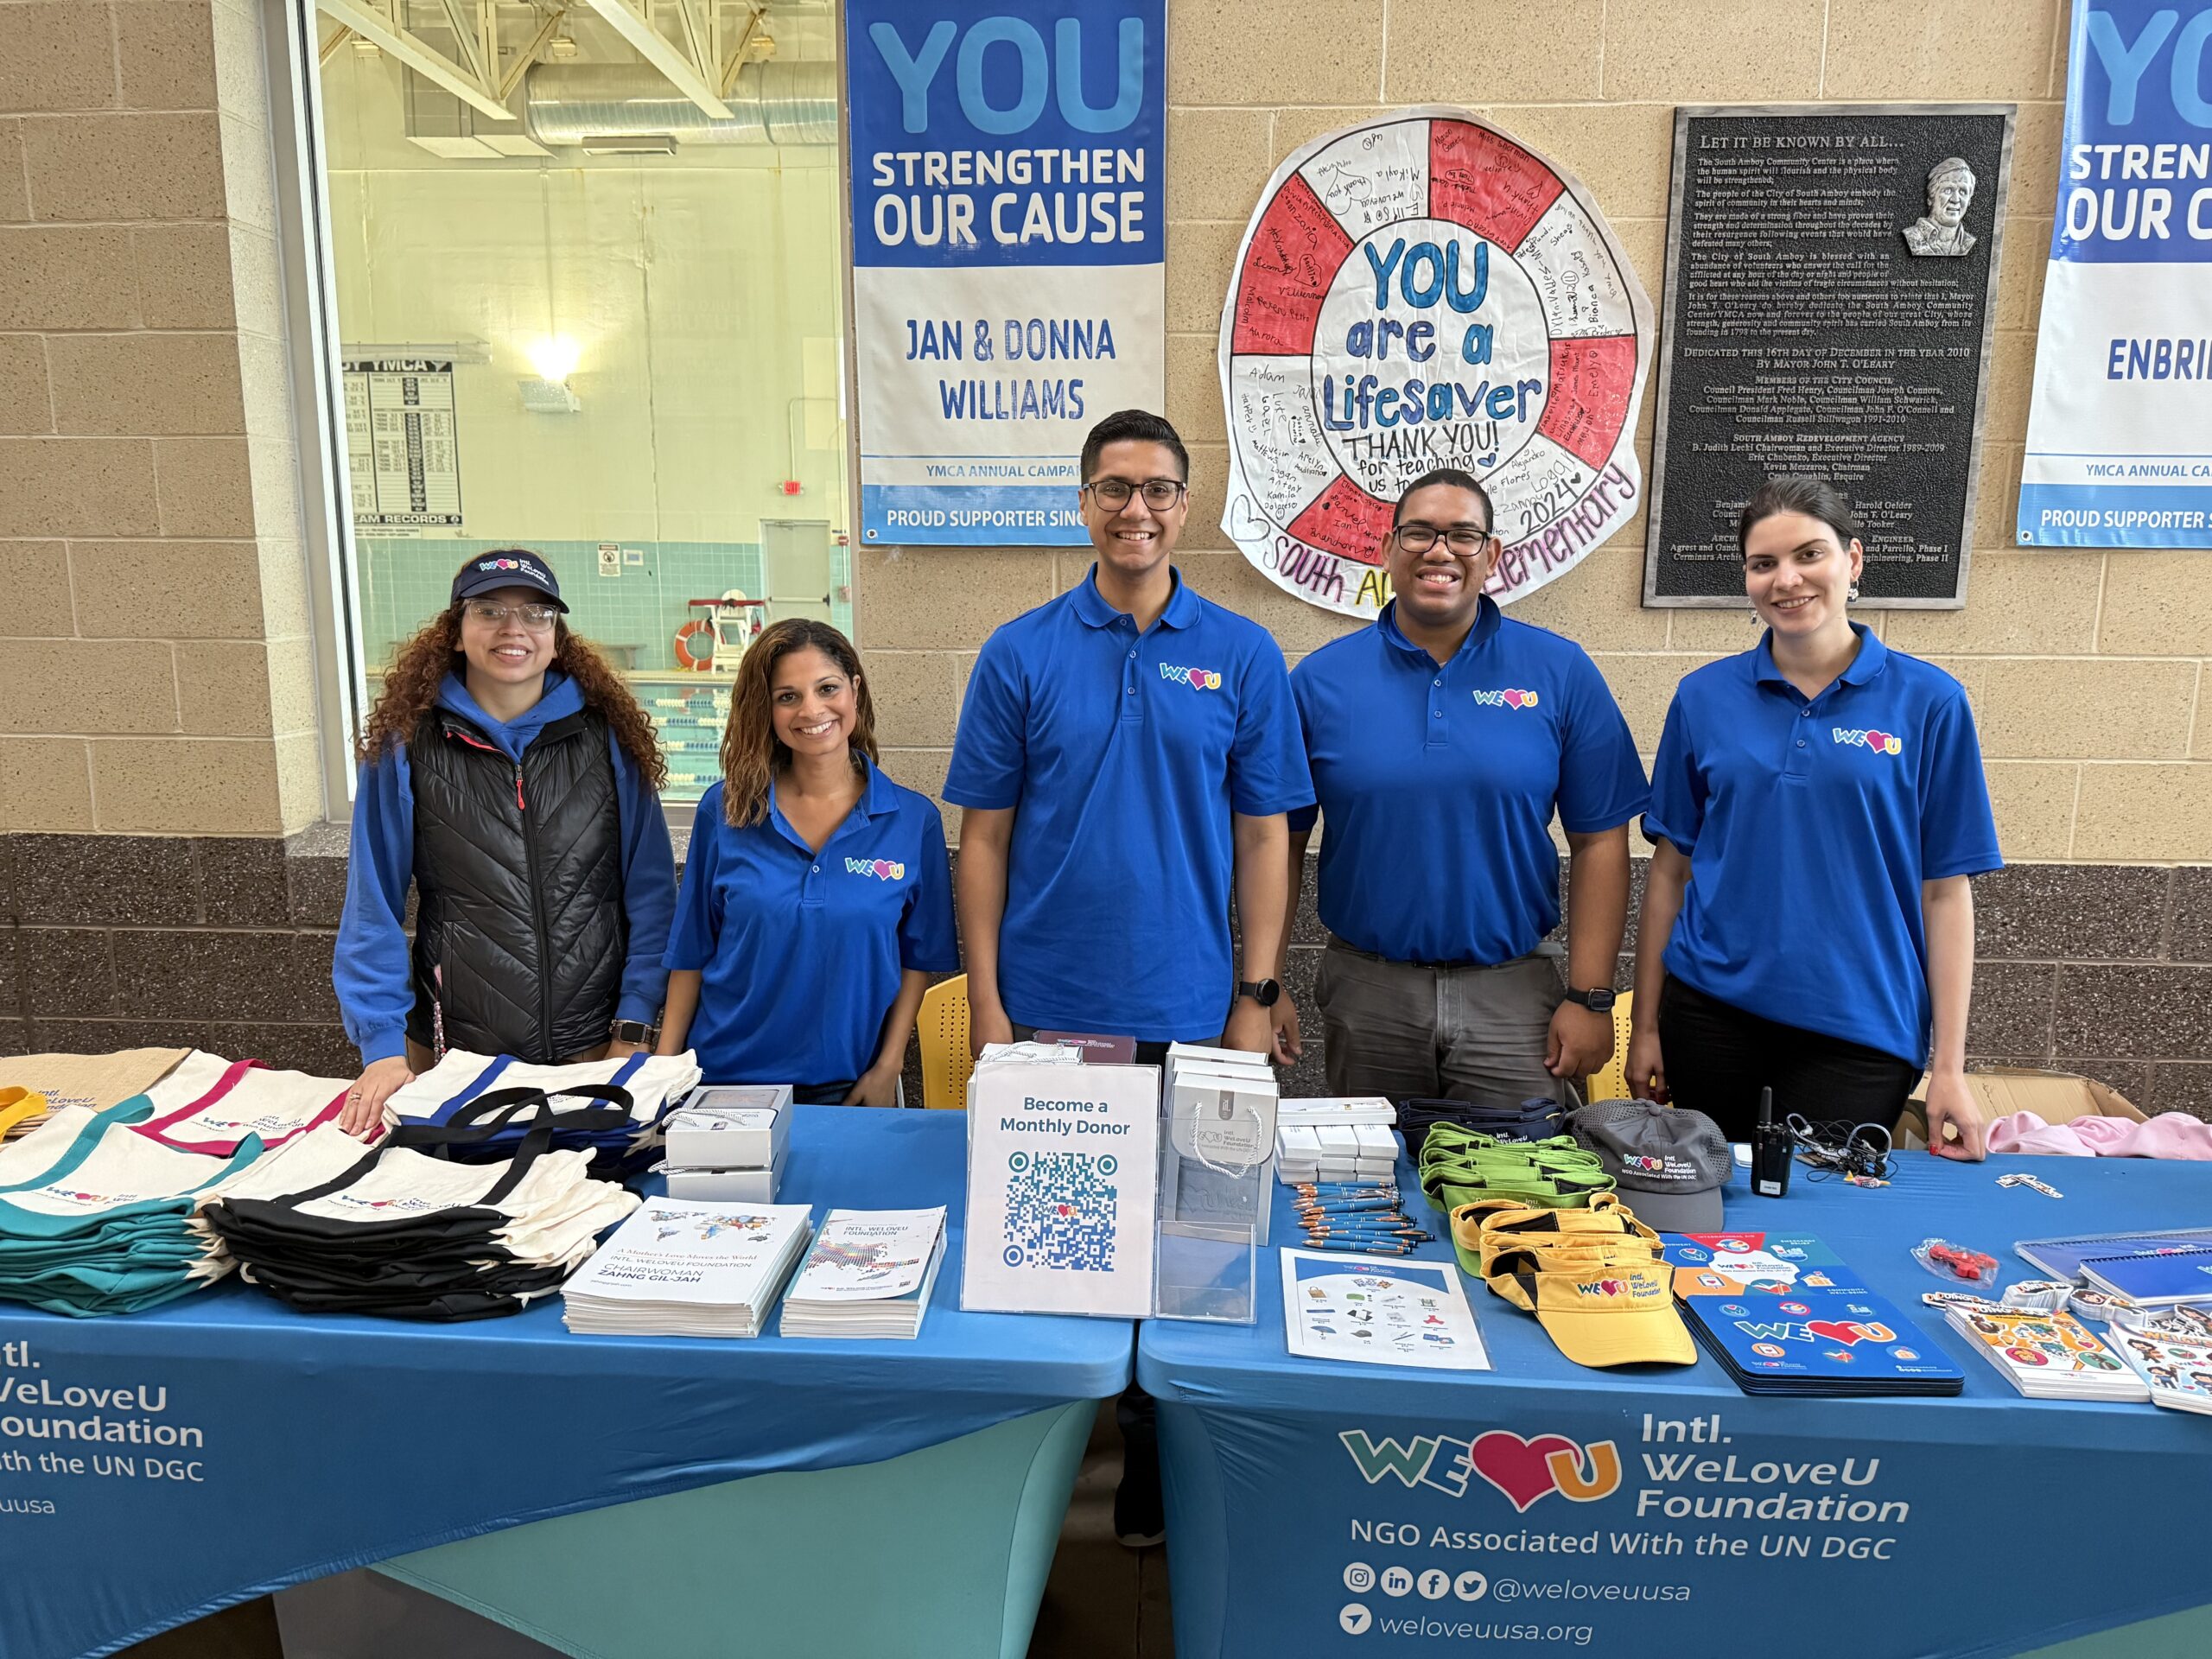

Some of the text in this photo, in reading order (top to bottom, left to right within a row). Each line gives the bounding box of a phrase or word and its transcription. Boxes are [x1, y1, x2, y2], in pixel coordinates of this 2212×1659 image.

[868, 16, 1144, 135] YOU
[1700, 135, 1728, 149] LET
[1733, 137, 1747, 149] IT
[1752, 137, 1771, 148] BE
[1776, 136, 1830, 148] KNOWN
[1834, 136, 1855, 148] BY
[873, 148, 1144, 187] STRENGTHEN
[2070, 144, 2210, 180] STREN
[874, 191, 1144, 245] OUR CAUSE
[2067, 188, 2171, 241] OUR
[1364, 238, 1488, 313] YOU
[906, 318, 1116, 361] JAN & DONNA
[1346, 319, 1493, 365] are a
[1684, 348, 1738, 357] DEDICATED
[1766, 348, 1789, 357] 16TH
[1830, 347, 1882, 357] DECEMBER
[1947, 347, 1970, 357] 2010
[372, 360, 428, 372] YMCA
[1249, 364, 1285, 383] Adam
[1756, 359, 1896, 369] BY MAYOR JOHN T. O'LEARY
[939, 379, 1084, 419] WILLIAMS
[1704, 385, 1735, 394] Council
[1777, 385, 1796, 394] Fred
[1798, 386, 1825, 396] Henry,
[1877, 386, 1904, 396] Joseph
[1324, 375, 1541, 430] Lifesaver
[1342, 421, 1500, 461] THANK YOU!
[1733, 434, 1762, 442] SOUTH
[1764, 434, 1794, 442] AMBOY
[926, 464, 1081, 477] YMCA ANNUAL CAMPAI
[1357, 453, 1476, 478] for teaching
[2087, 464, 2212, 477] YMCA ANNUAL CA
[1369, 478, 1386, 493] us
[1501, 471, 1530, 487] Flores
[1520, 478, 1579, 534] 2024
[354, 515, 447, 524] EAM RECORDS
[887, 510, 1088, 527] PROUD SUPPORTER SINC
[2042, 510, 2204, 529] PROUD SUPPORTER
[1160, 663, 1221, 690] WE U
[1473, 690, 1538, 708] WE U
[1833, 728, 1902, 755] WE U
[845, 857, 905, 880] WE U
[1024, 1096, 1108, 1113] Become a
[1001, 1117, 1130, 1136] Monthly Donor
[1624, 1154, 1662, 1170] WE U
[604, 1263, 704, 1276] CHAIRWOMAN
[636, 1258, 685, 1267] WELOVEU
[598, 1269, 702, 1283] ZAHNG GIL-JAH
[1576, 1279, 1630, 1295] WE U
[1631, 1281, 1658, 1289] WeLoveU
[1733, 1321, 1897, 1343] WE U
[0, 1340, 41, 1368] tl.
[0, 1415, 204, 1448] oundation
[1642, 1413, 1732, 1443] Intl.
[0, 1450, 204, 1482] th the UN DGC
[1338, 1428, 1622, 1503] WE U
[1642, 1453, 1880, 1485] WeLoveU
[0, 1499, 55, 1514] uusa
[1636, 1490, 1910, 1523] Foundation
[1351, 1519, 1897, 1560] NGO Associated With the UN DGC
[1492, 1578, 1692, 1603] @weloveuusa
[1379, 1616, 1593, 1646] weloveuusa.org
